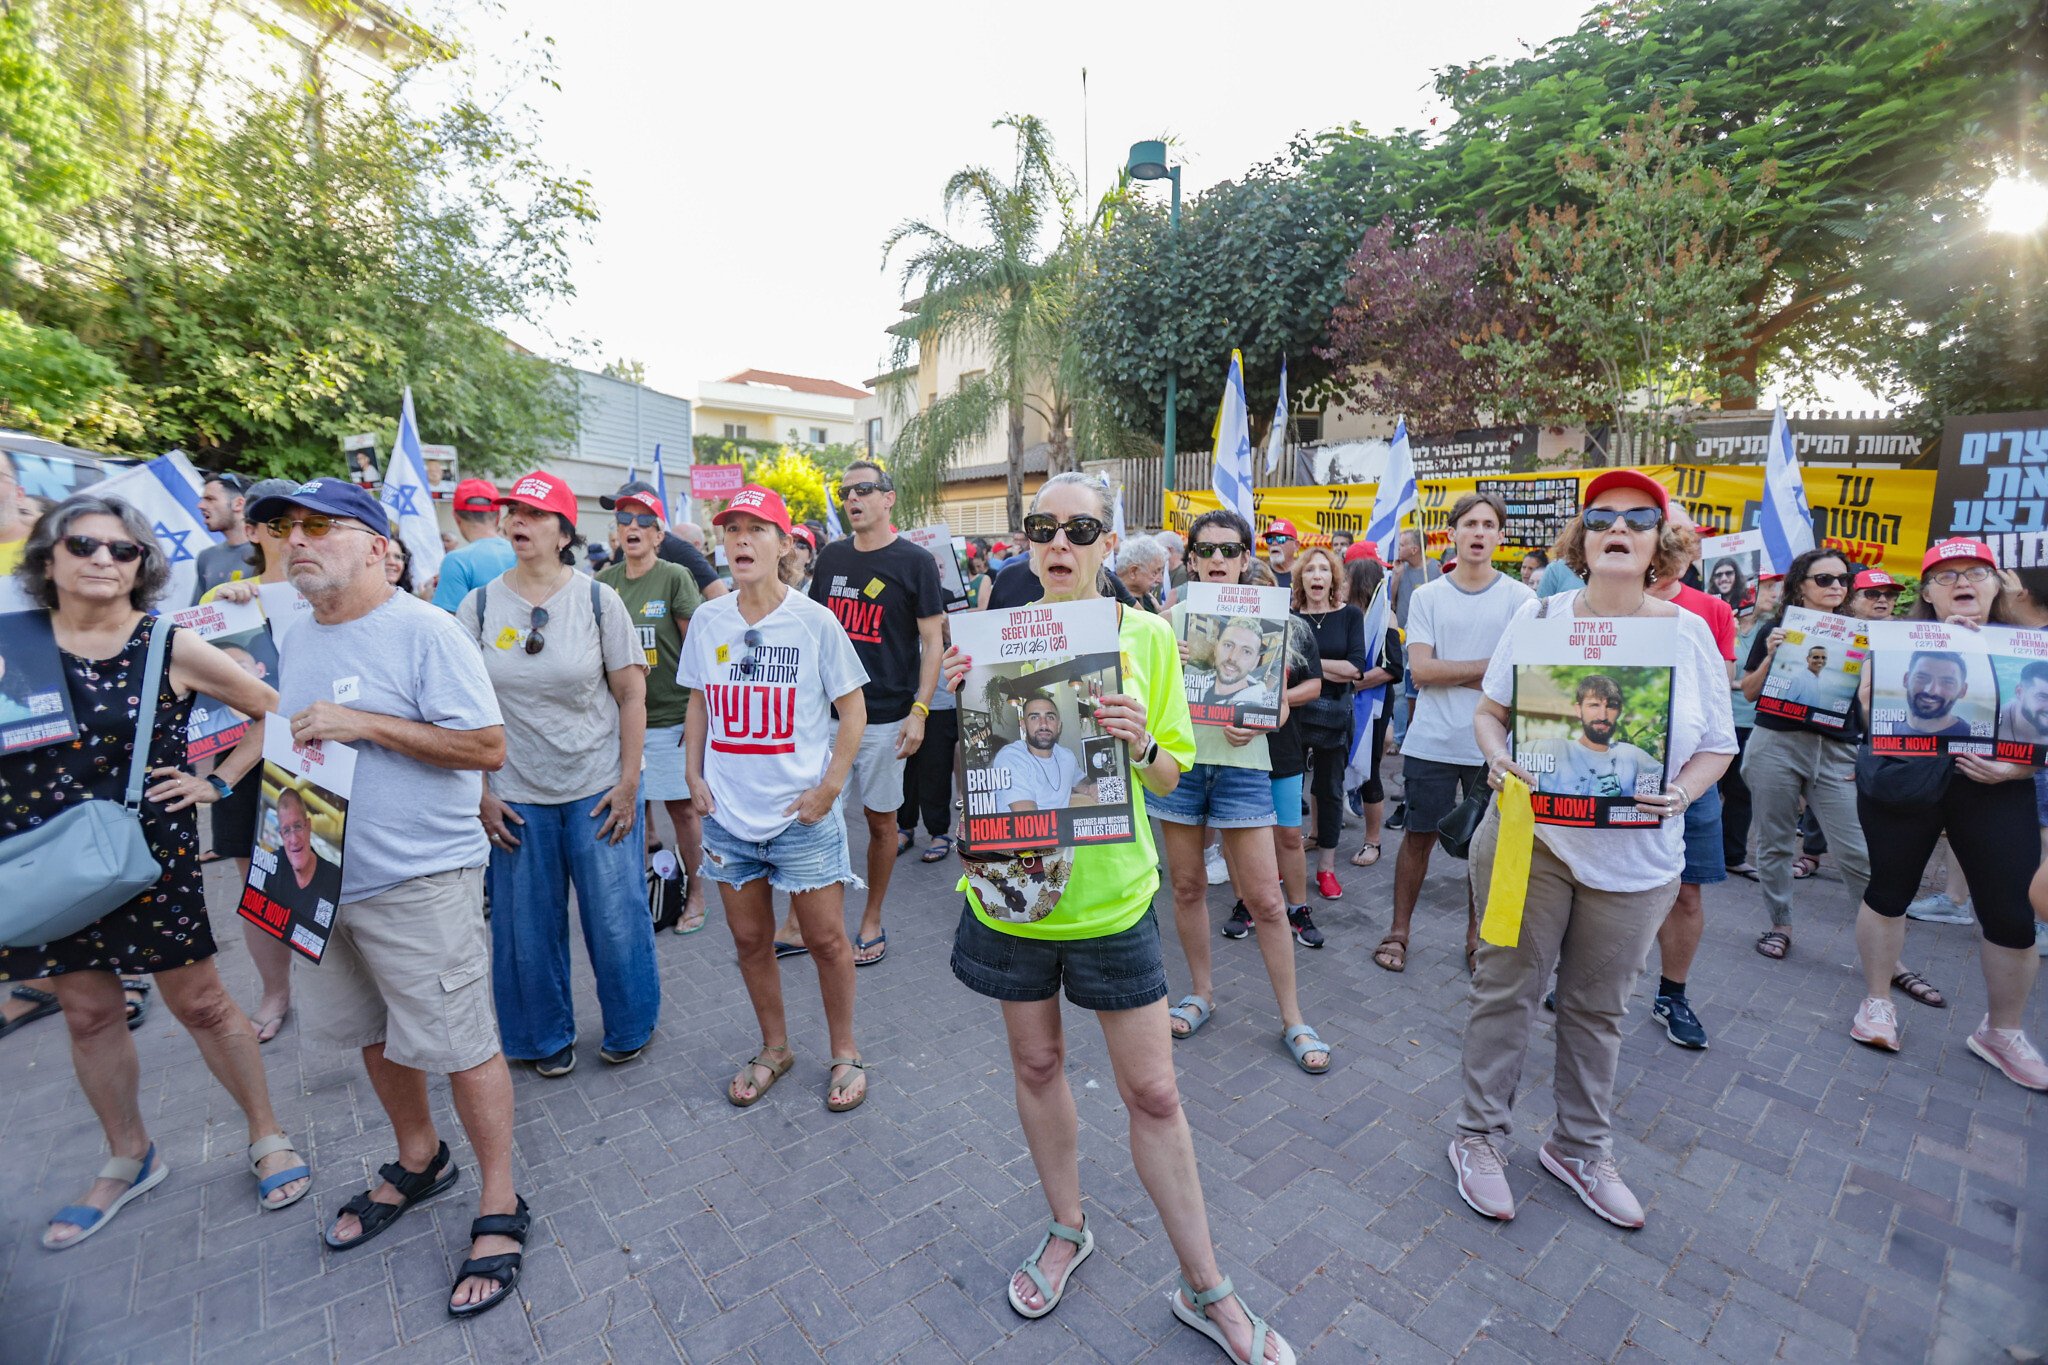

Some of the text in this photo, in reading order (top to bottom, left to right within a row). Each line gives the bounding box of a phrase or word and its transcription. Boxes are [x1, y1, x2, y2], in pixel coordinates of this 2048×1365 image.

[1855, 434, 1922, 455] אחוות
[1674, 467, 1706, 498] עד
[1837, 474, 1875, 507] עד
[516, 487, 547, 500] WAR
[1328, 490, 1348, 510] עד
[1424, 485, 1447, 506] עד
[730, 498, 761, 508] WAR
[1317, 512, 1362, 535] החטוף
[1940, 549, 1977, 559] WAR
[842, 587, 860, 599] HOME
[1217, 594, 1239, 603] ELKANA
[827, 596, 883, 637] NOW!
[1010, 608, 1053, 626] שגב כלפון
[1001, 621, 1064, 641] SEGEV KALFON
[1569, 634, 1617, 646] GUY ILLOUZ
[1909, 632, 1951, 640] GALI BERMAN
[755, 645, 800, 666] מחזירים
[1584, 647, 1601, 660] (26)
[767, 664, 799, 684] אותם
[1184, 673, 1211, 690] BRING
[1765, 675, 1792, 690] BRING
[1187, 688, 1199, 703] IM
[1762, 685, 1780, 698] HIM
[705, 683, 797, 740] עכשיו
[1207, 704, 1235, 721] NOW!
[1760, 696, 1808, 717] HOME NOW!
[1872, 708, 1906, 722] BRING
[1872, 722, 1893, 735] HIM
[1872, 737, 1903, 750] HOME
[1904, 736, 1938, 751] NOW!
[1996, 742, 2035, 760] NOW!
[1516, 752, 1555, 774] BRING
[966, 767, 1012, 792] BRING
[969, 790, 998, 816] HIM
[1554, 796, 1596, 819] NOW!
[970, 810, 1059, 842] HOME NOW!
[1108, 814, 1129, 824] MISSING
[1609, 812, 1637, 823] FAMILIES
[1074, 822, 1130, 838] FAMILIES FORUM
[252, 845, 278, 875] BRING
[248, 864, 267, 891] HIM
[242, 887, 292, 931] HOME NOW!
